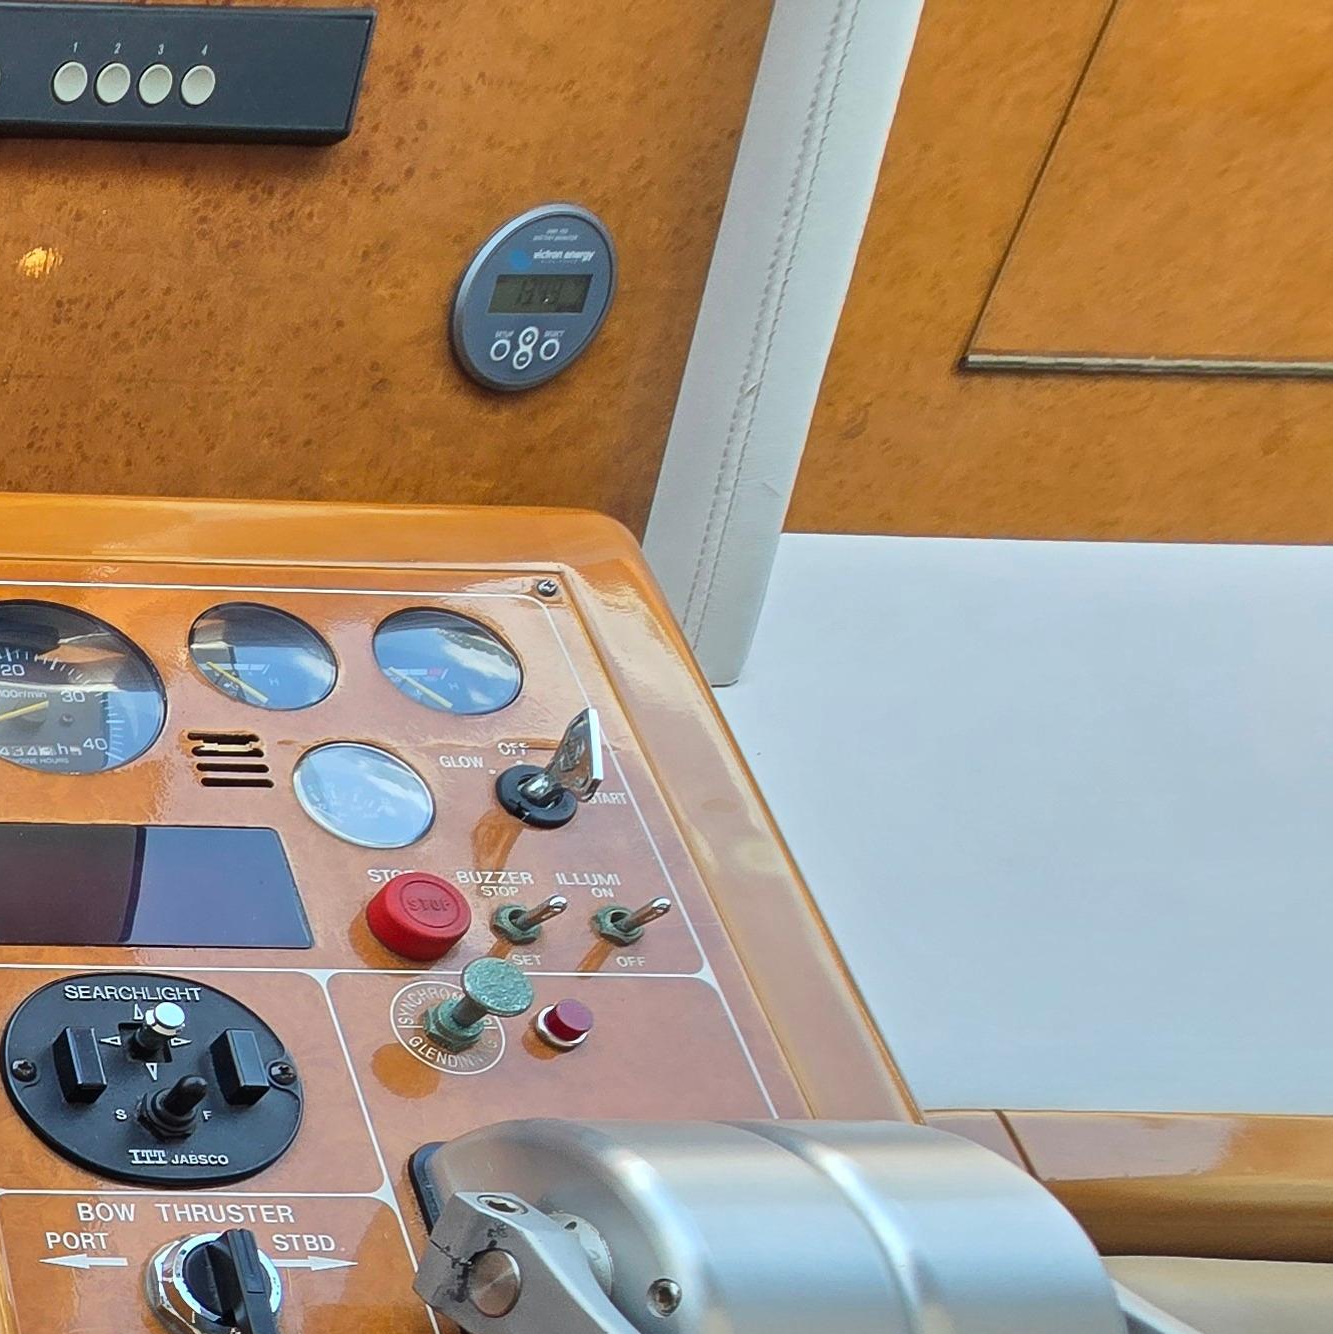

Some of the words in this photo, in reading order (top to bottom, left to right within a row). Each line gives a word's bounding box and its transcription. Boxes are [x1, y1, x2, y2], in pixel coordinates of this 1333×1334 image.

[114, 42, 122, 54] 2
[158, 43, 165, 55] 3
[1, 664, 25, 677] 20
[60, 690, 85, 703] 30
[83, 738, 108, 750] 40
[439, 756, 484, 768] GLOW
[455, 871, 534, 885] BUZZER
[555, 873, 621, 886] ILLUMI
[482, 886, 519, 897] STOP
[591, 887, 614, 898] ON
[511, 955, 542, 966] SET
[616, 957, 646, 968] OFF
[64, 985, 201, 1001] SEARCHLIGHT
[115, 1109, 128, 1121] S
[202, 1110, 213, 1121] F
[171, 1154, 229, 1166] JABSCO
[77, 1203, 135, 1222] BOW
[155, 1204, 295, 1223] THRUSTER
[46, 1232, 109, 1250] PORT
